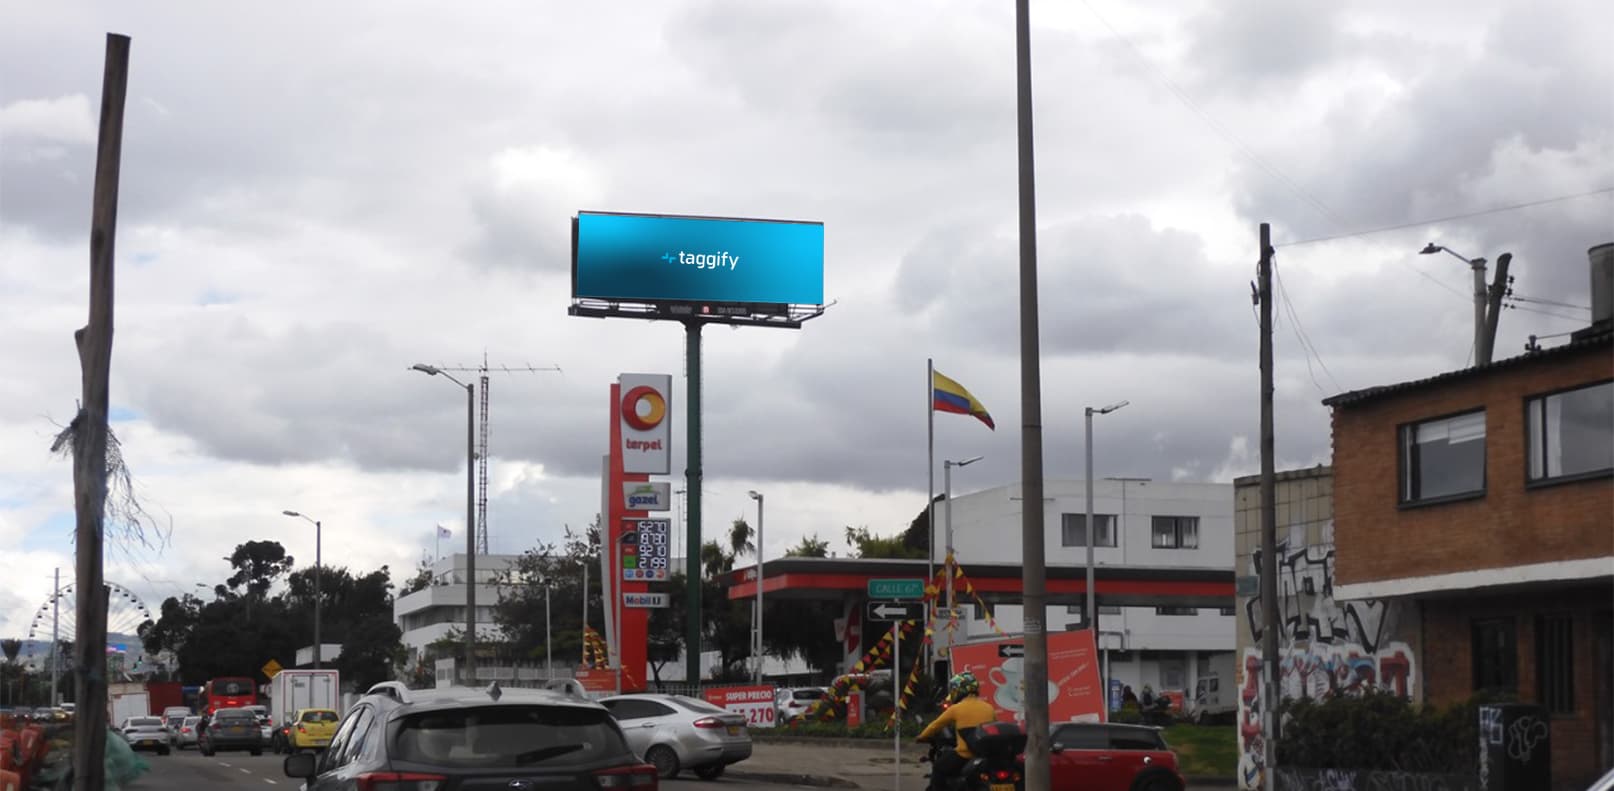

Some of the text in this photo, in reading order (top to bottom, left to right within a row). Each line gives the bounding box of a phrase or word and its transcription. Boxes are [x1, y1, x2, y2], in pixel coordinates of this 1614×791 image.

[678, 250, 739, 271] taggify
[625, 437, 662, 452] terpel
[628, 493, 659, 507] gazel
[875, 583, 901, 593] CALLE
[626, 595, 651, 605] Mobil
[725, 691, 746, 701] SUPER
[747, 690, 772, 700] PRECIO
